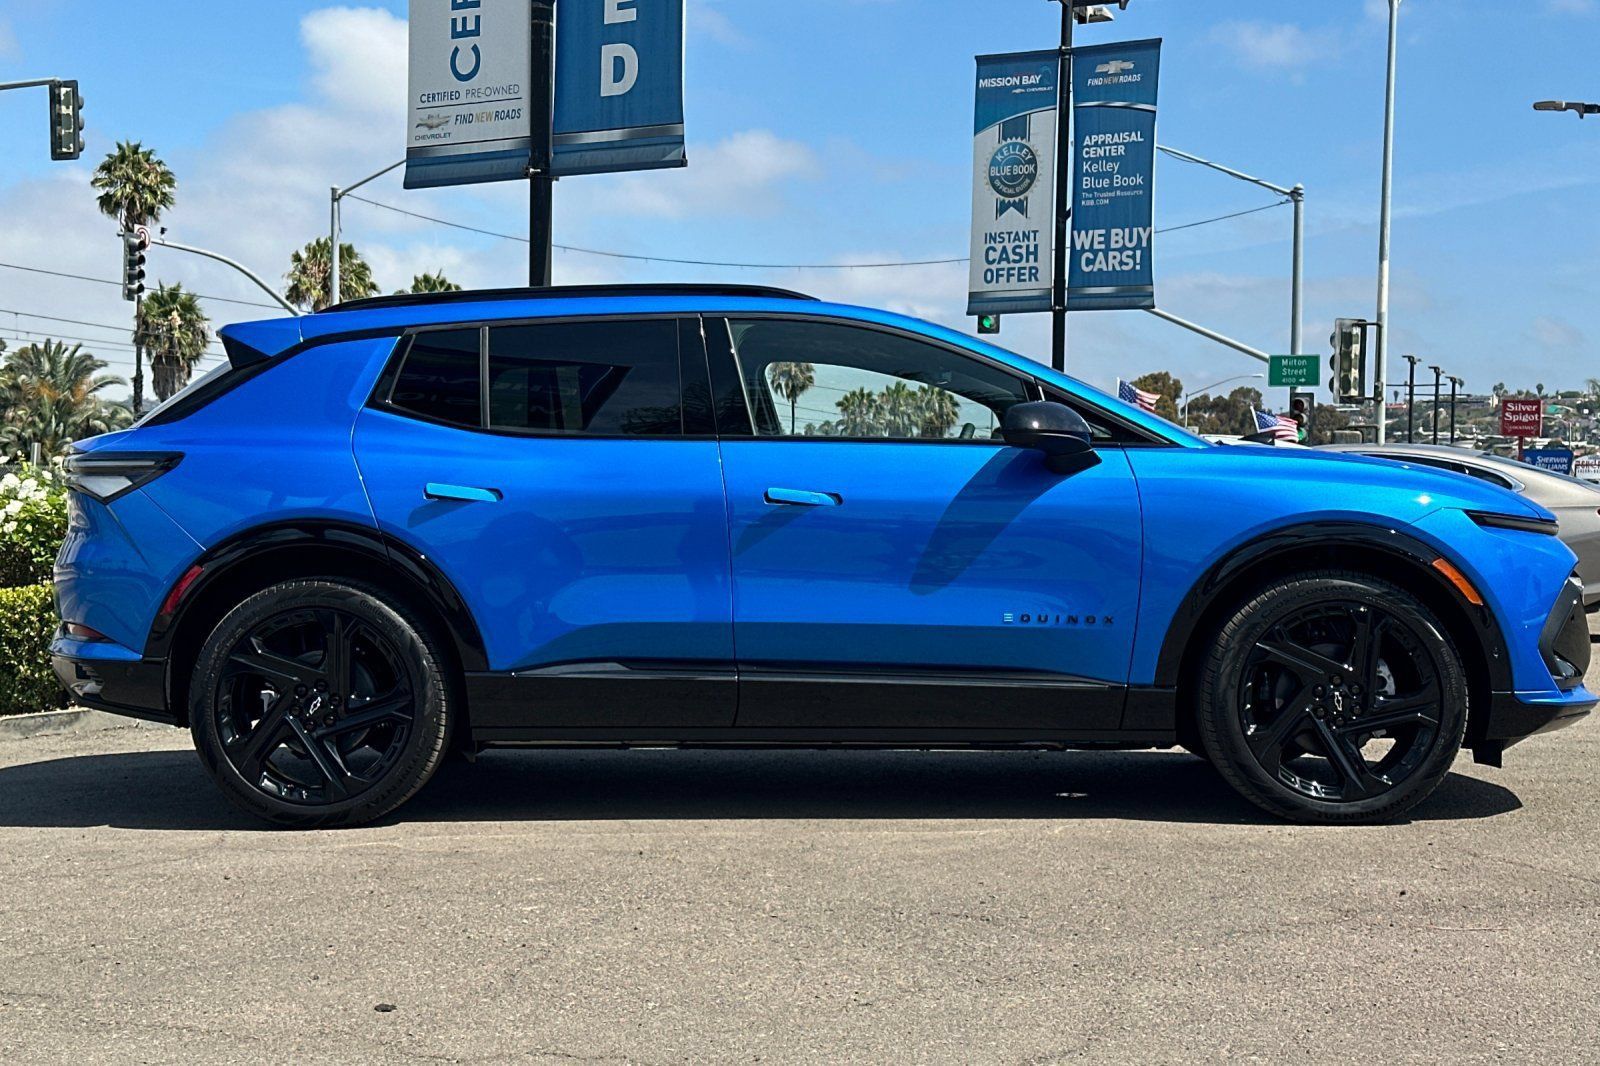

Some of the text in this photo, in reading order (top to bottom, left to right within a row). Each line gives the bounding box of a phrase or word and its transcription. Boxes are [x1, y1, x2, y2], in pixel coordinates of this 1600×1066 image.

[979, 74, 1041, 88] MISSION BAY
[1087, 73, 1141, 87] FIND NEW ROADS
[420, 84, 520, 104] CERTIFIED PRE-OWNED
[454, 108, 522, 125] FIND NEW ROADS
[414, 132, 451, 141] CHEVROLET
[1083, 131, 1144, 146] APPRAISAL
[995, 145, 1033, 161] KELLEY
[1082, 145, 1125, 158] CENTER
[990, 164, 1036, 176] BLUE BOOK
[1083, 160, 1120, 174] Kelley
[1082, 173, 1144, 189] Blue Book
[1094, 190, 1116, 198] Trusted
[984, 230, 1039, 245] INSTANT
[1073, 226, 1152, 250] WE BUY
[984, 243, 1039, 266] CASH
[1080, 250, 1142, 273] CARS!
[983, 266, 1040, 284] OFFER
[1281, 358, 1307, 366] Milton
[1281, 367, 1307, 376] Street
[1506, 402, 1538, 412] Silver
[1503, 412, 1540, 422] Spigot
[1536, 455, 1568, 463] SHERWIN
[1003, 613, 1114, 624] EQUINOX
